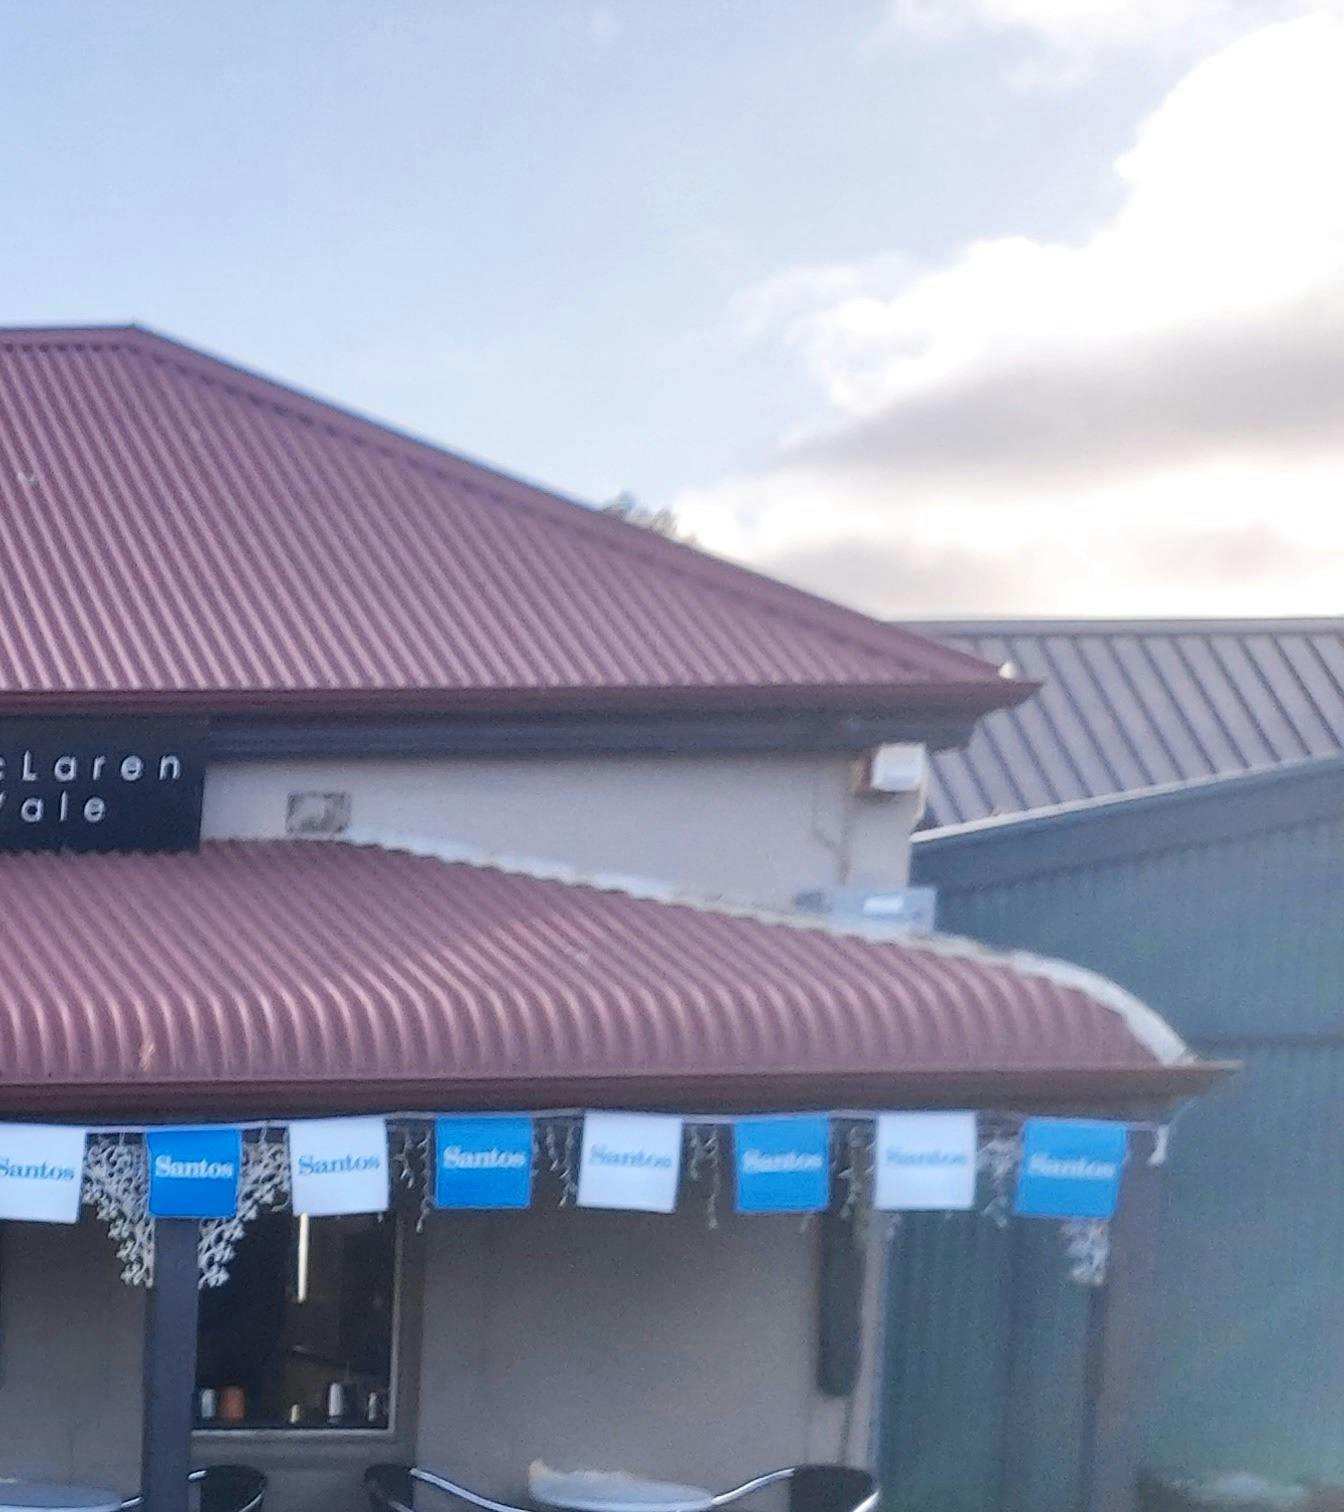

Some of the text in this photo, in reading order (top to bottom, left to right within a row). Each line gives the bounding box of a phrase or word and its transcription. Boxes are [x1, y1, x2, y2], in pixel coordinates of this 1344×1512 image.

[154, 1155, 234, 1179] Santos
[297, 1154, 381, 1175] Santos
[443, 1150, 527, 1169] Santos
[589, 1147, 673, 1169] Santos
